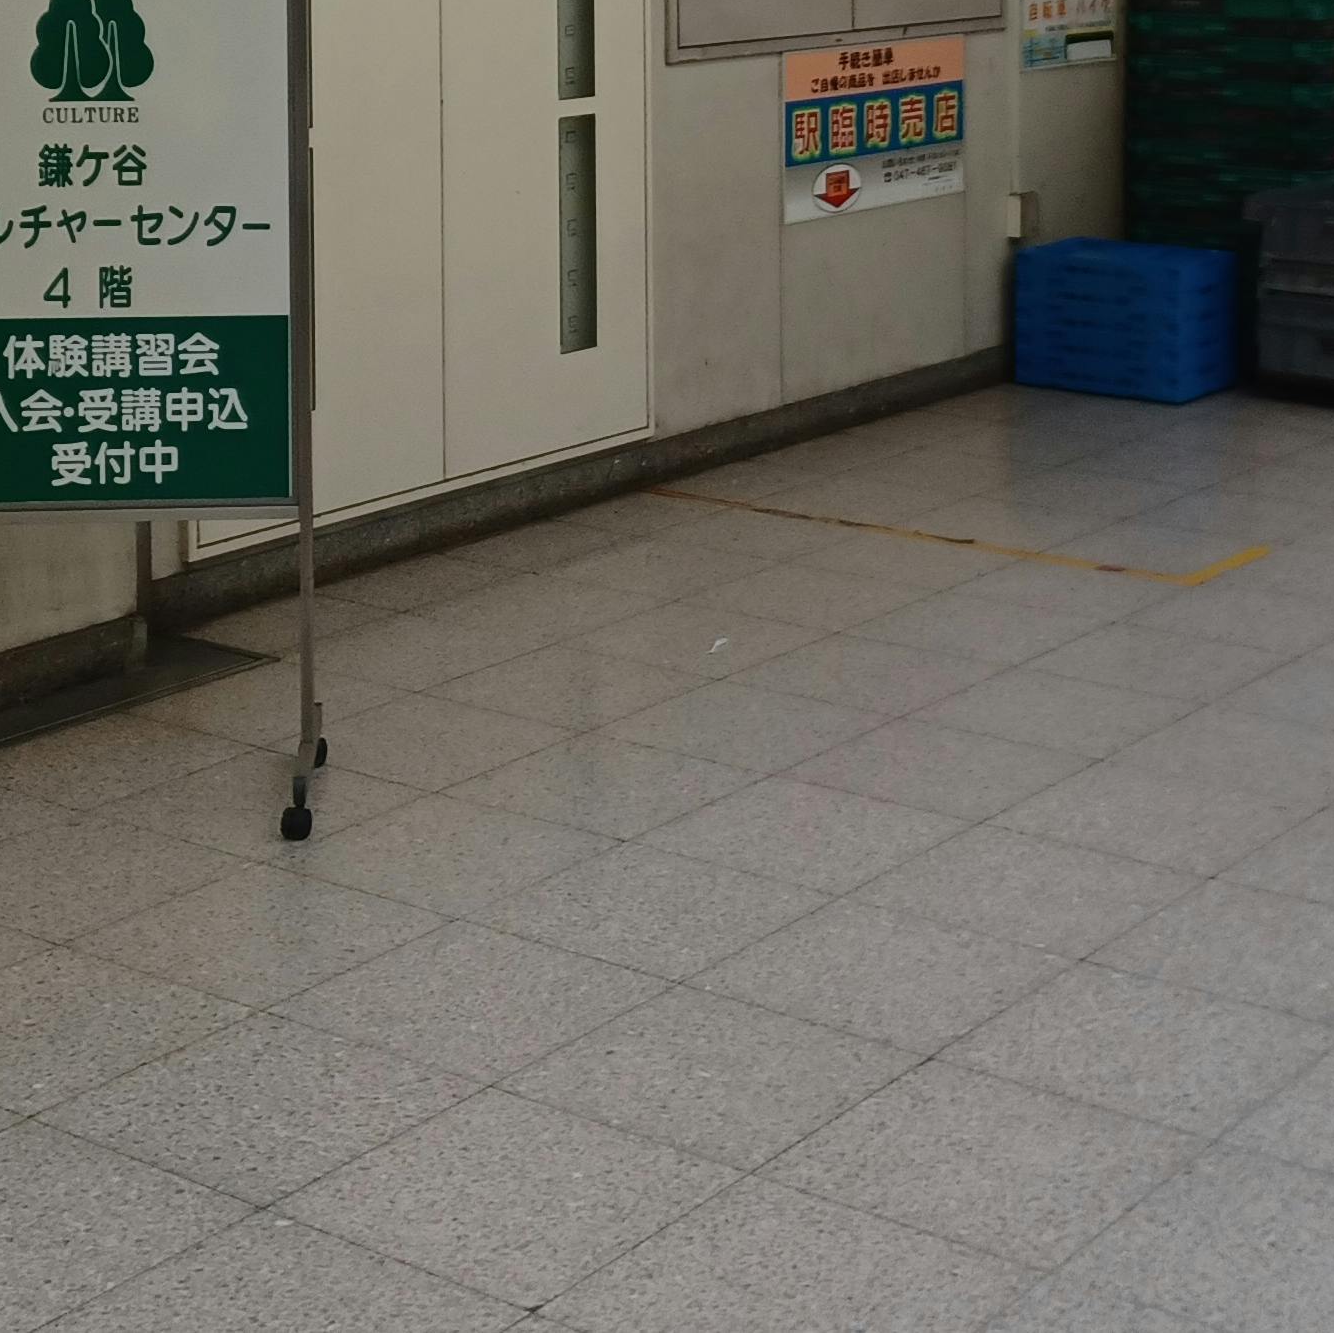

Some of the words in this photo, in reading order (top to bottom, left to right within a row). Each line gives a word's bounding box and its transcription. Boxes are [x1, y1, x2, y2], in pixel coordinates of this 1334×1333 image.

[838, 47, 895, 70] 手続き簡単
[42, 106, 140, 124] CULTURE
[793, 91, 958, 156] 駅臨時売店
[3, 332, 221, 379] 体験講習会
[51, 439, 179, 487] 受付中
